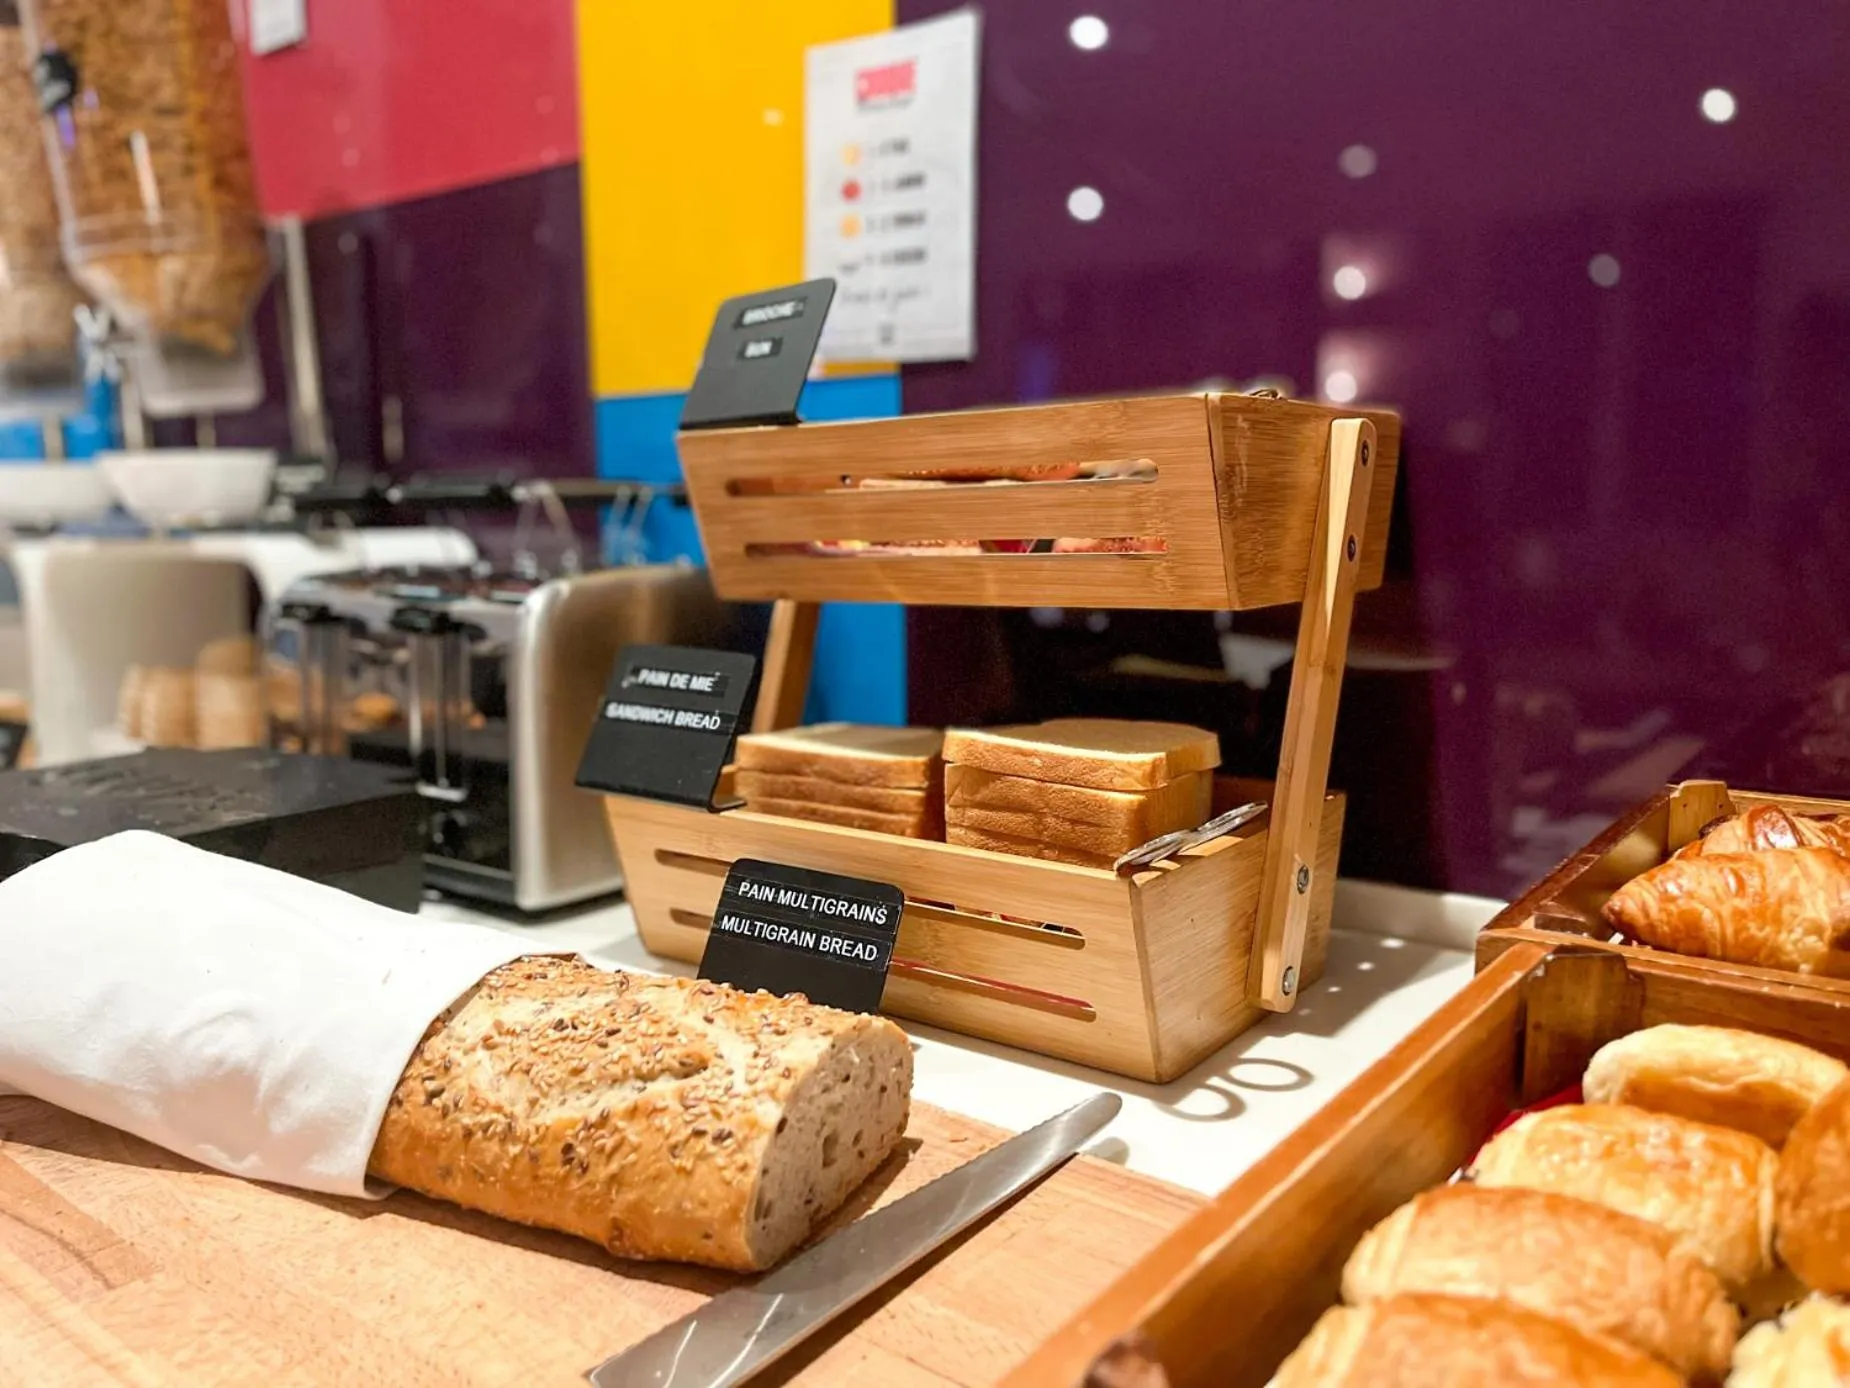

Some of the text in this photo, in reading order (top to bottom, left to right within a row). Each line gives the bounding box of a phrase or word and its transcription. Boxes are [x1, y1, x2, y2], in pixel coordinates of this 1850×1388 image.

[638, 669, 669, 688] PAIN
[670, 673, 689, 689] DE
[605, 702, 721, 730] SANDWICH BREAD
[738, 882, 888, 925] PAIN MULTIGRAINS
[721, 915, 878, 961] MULTIGRAIN BREAD
